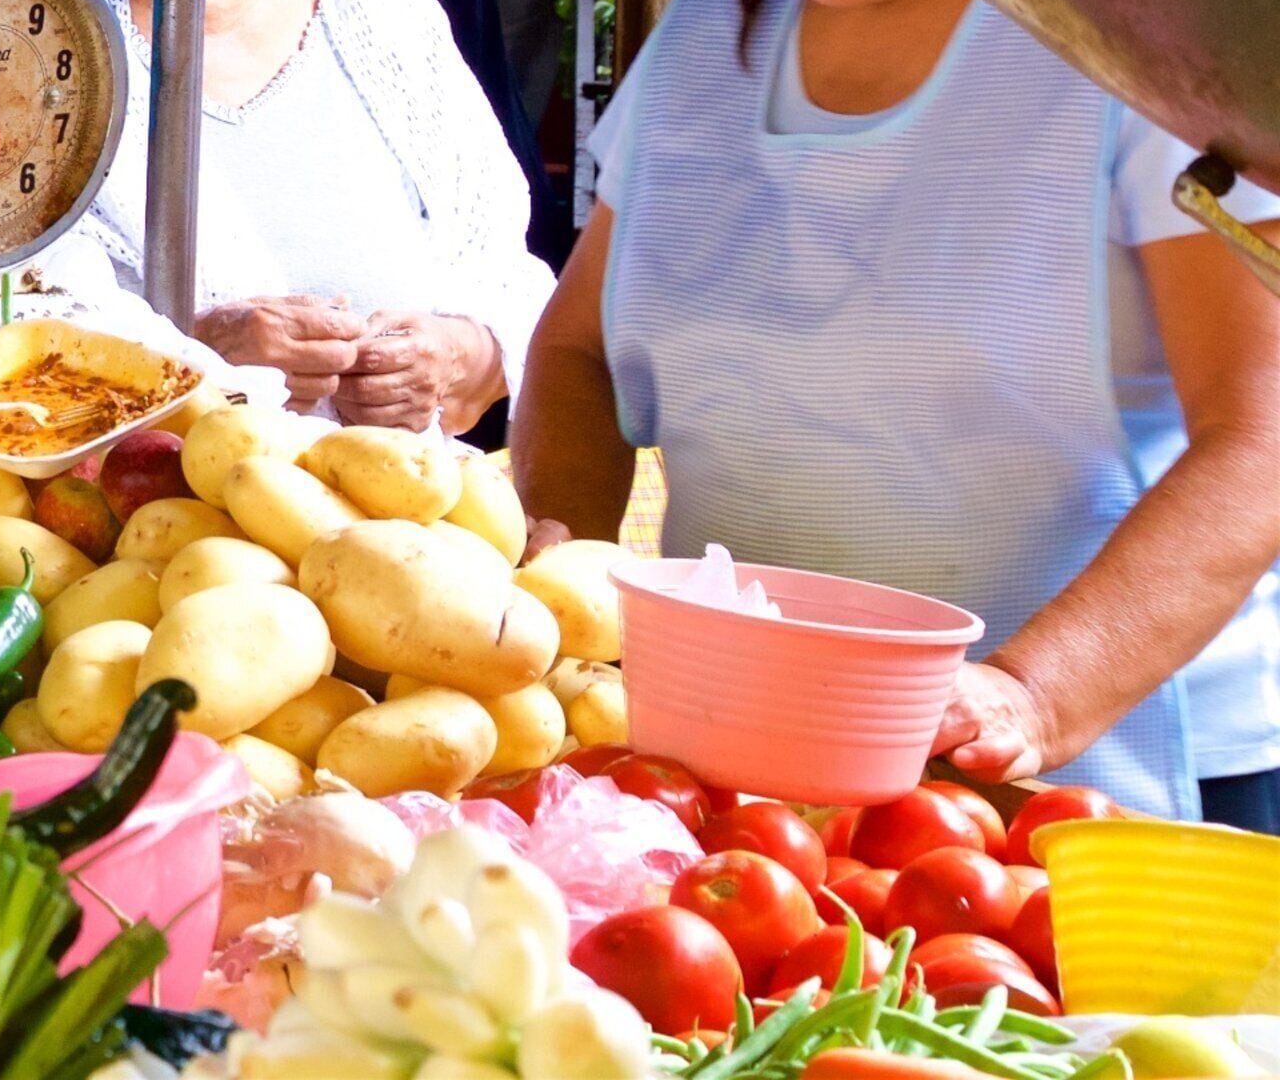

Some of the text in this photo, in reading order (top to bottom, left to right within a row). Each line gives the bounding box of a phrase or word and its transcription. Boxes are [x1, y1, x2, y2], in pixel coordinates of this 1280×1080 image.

[28, 3, 45, 36] 9
[56, 49, 73, 81] 8
[54, 113, 70, 144] 7
[19, 162, 36, 194] 6
